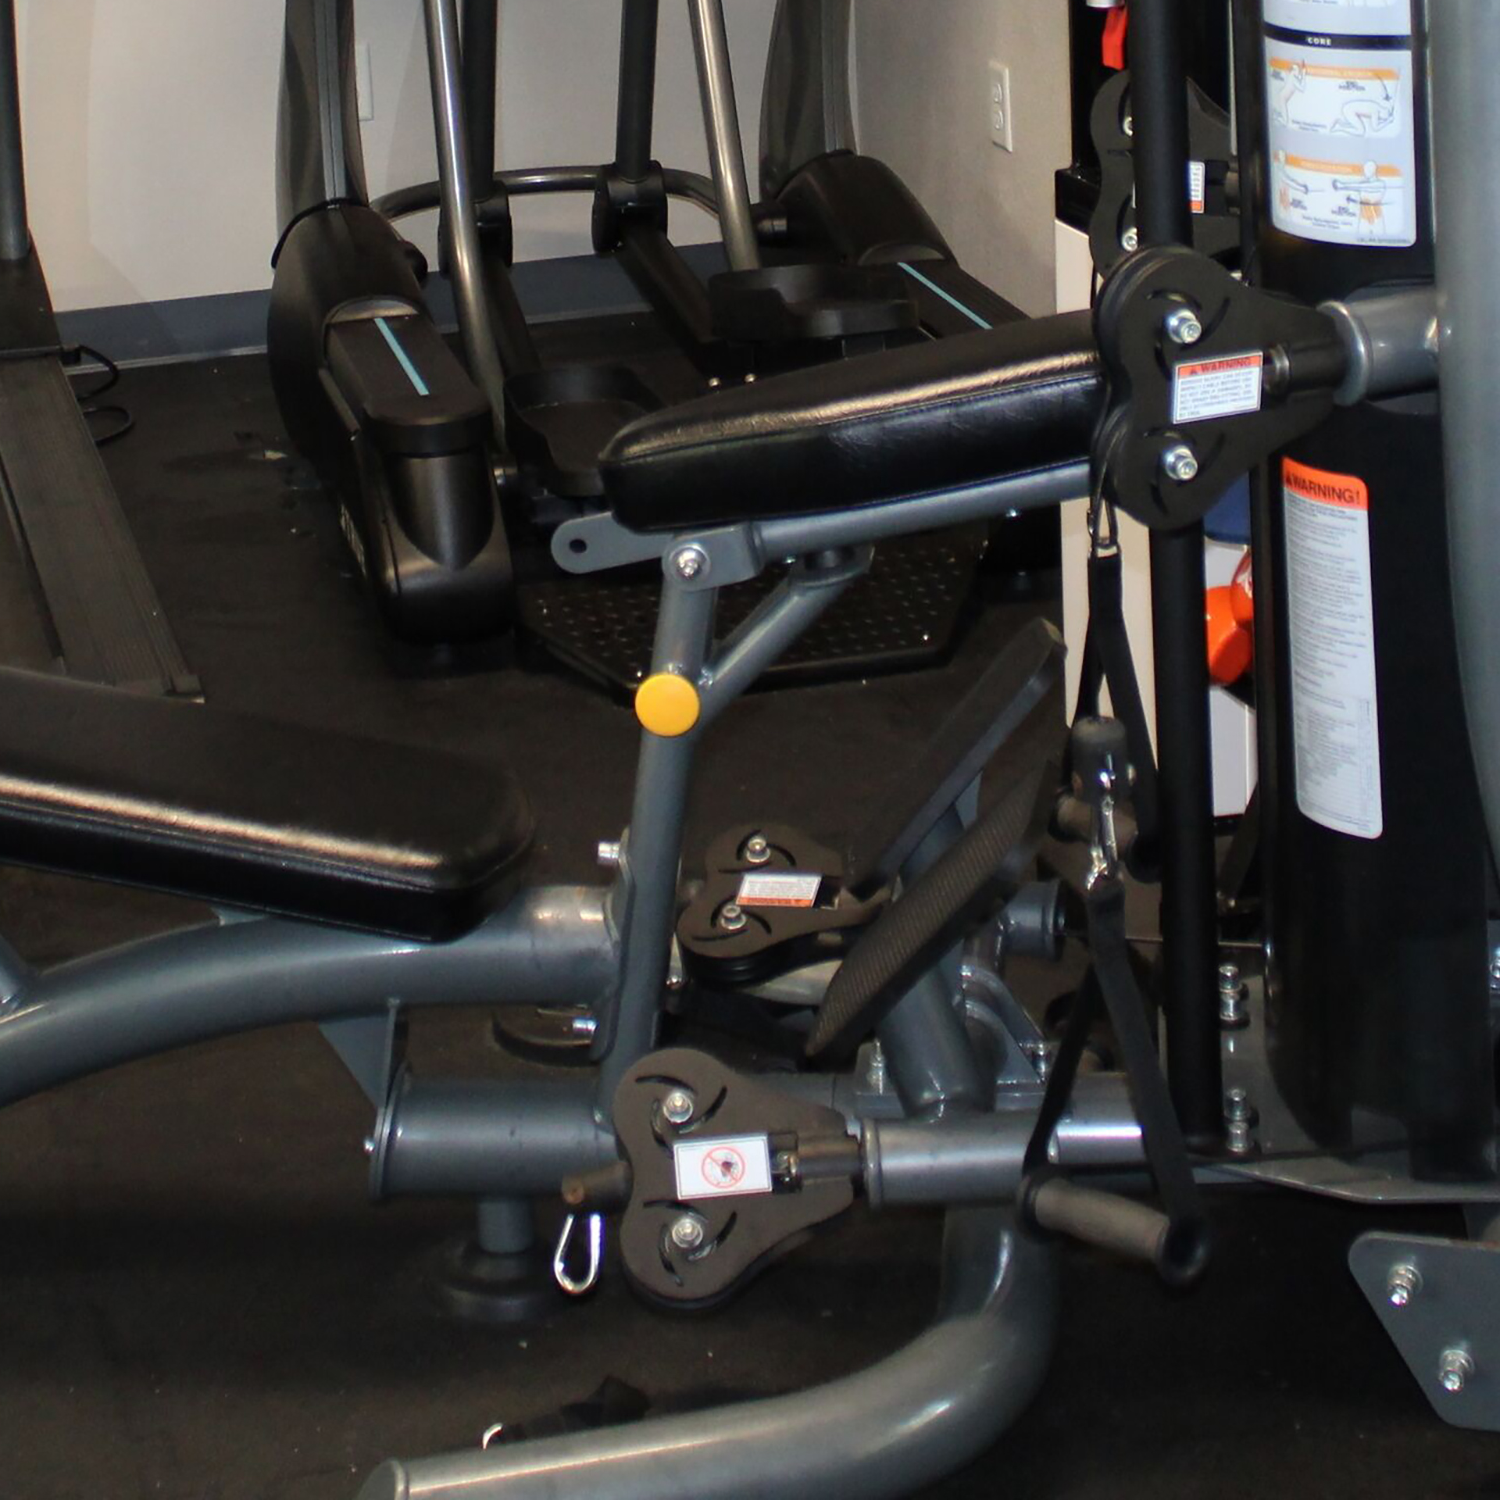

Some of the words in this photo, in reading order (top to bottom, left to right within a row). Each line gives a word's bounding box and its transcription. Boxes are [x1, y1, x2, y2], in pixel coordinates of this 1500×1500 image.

[1307, 36, 1332, 46] CORE
[1200, 358, 1251, 372] WARNING
[1293, 473, 1361, 505] WARNING!
